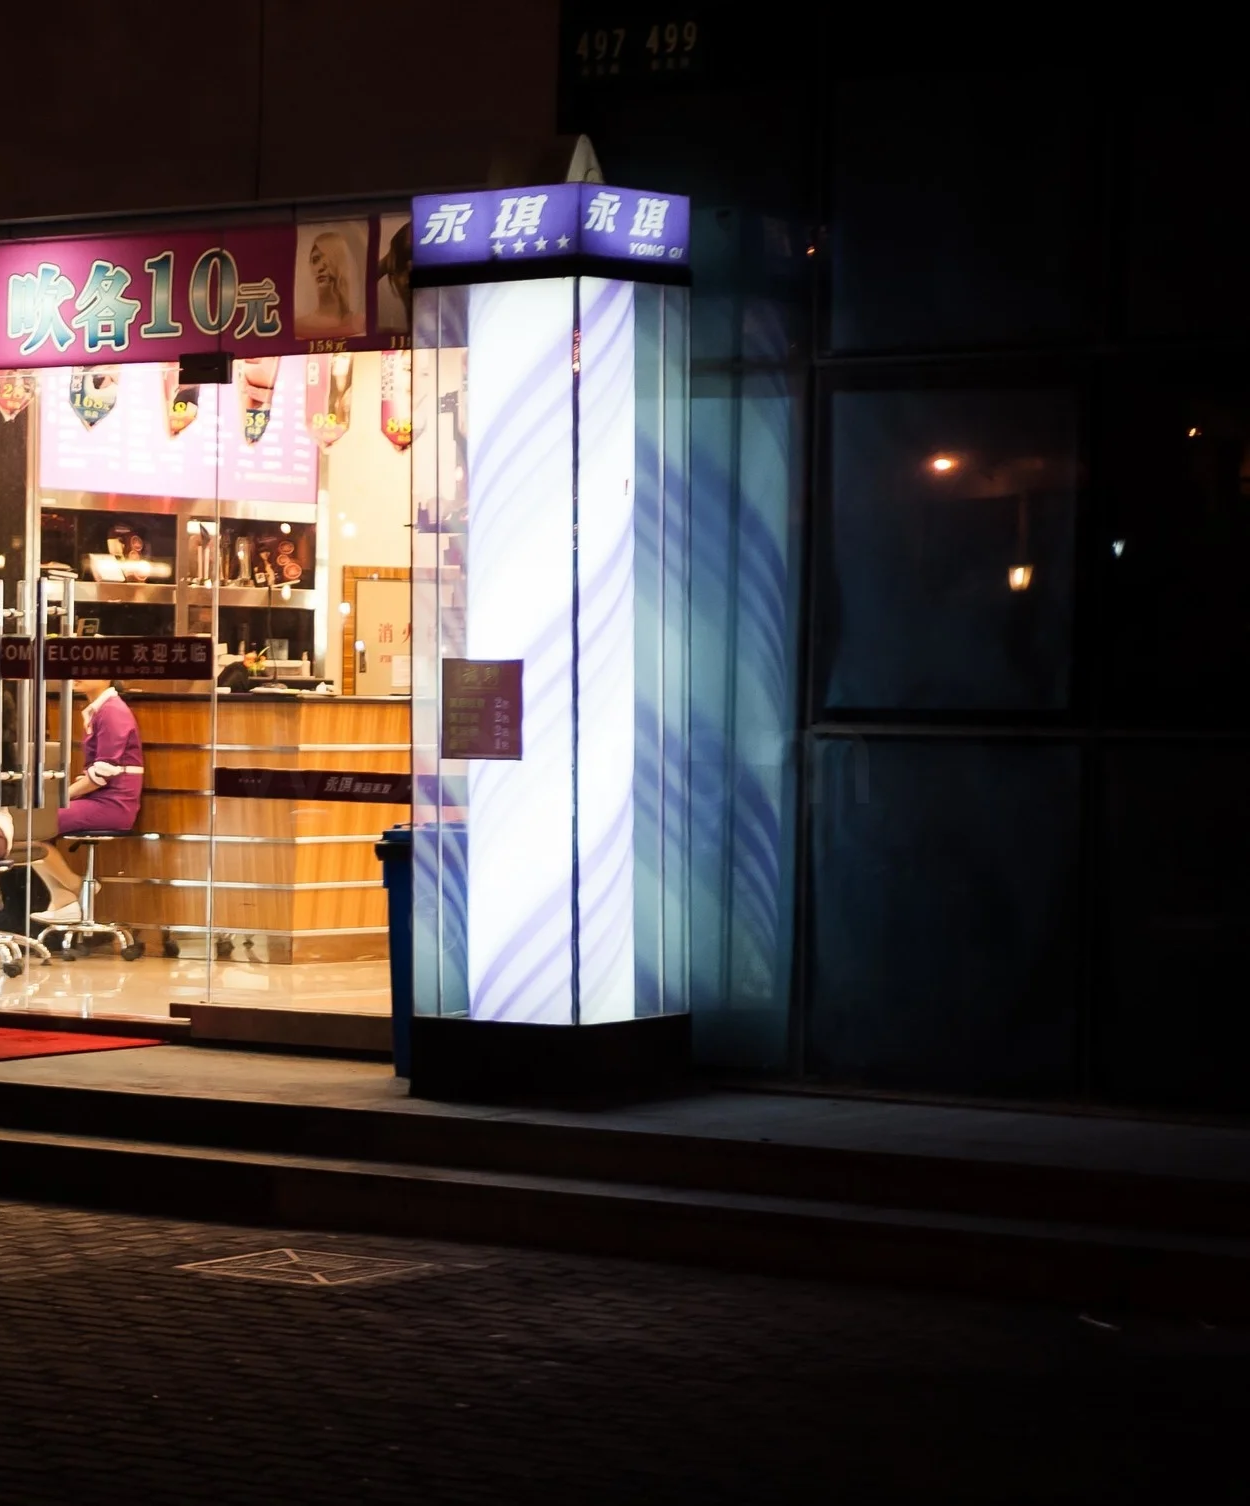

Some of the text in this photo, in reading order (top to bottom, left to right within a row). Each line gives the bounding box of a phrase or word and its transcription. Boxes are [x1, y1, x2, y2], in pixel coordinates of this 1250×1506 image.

[576, 20, 697, 61] 497 499
[420, 195, 548, 245] 永琪
[584, 191, 669, 237] 永琪
[629, 242, 663, 257] YONG
[44, 643, 207, 663] ELCOME 欢迎光临
